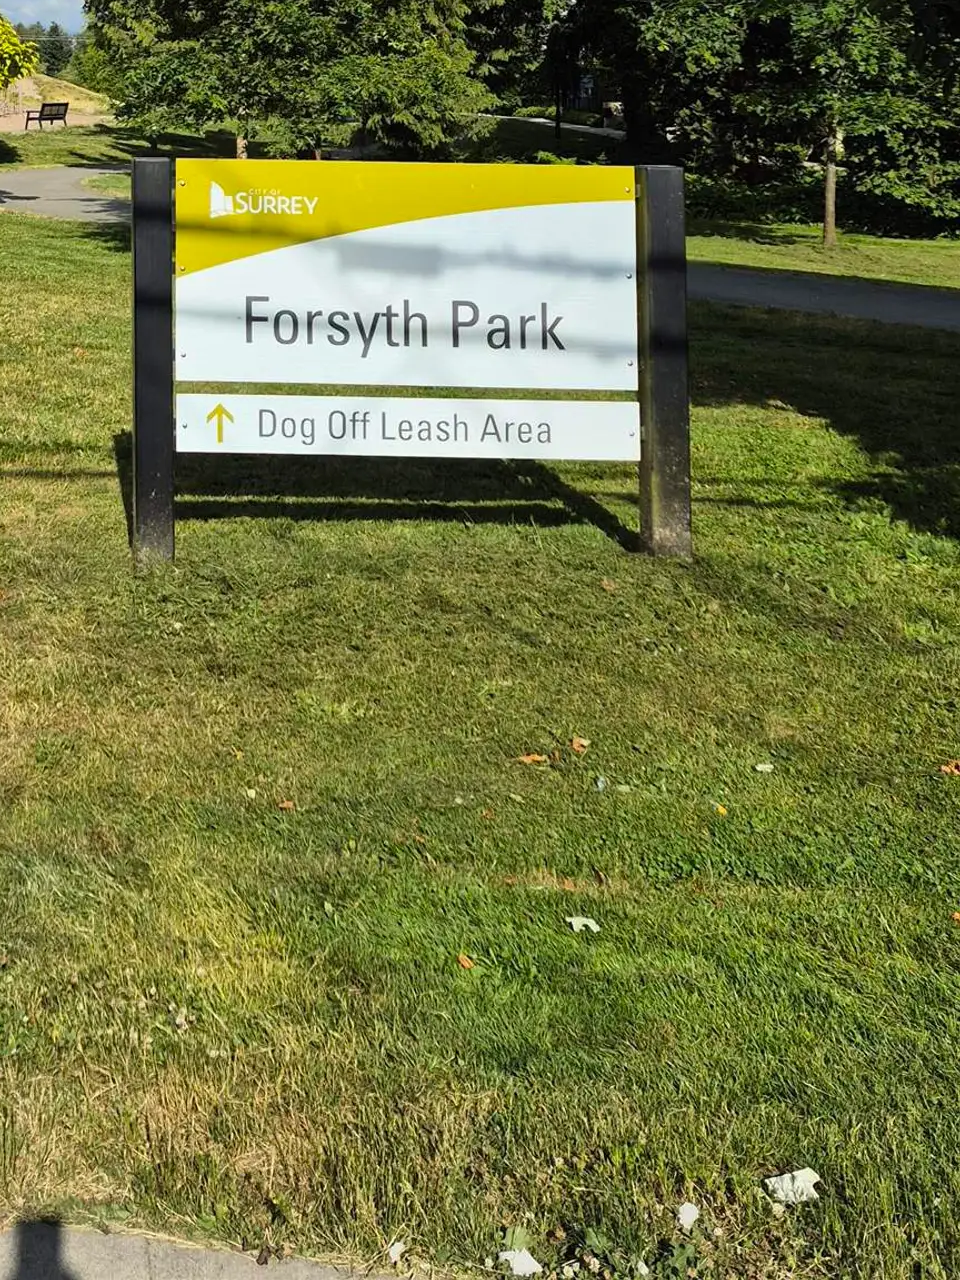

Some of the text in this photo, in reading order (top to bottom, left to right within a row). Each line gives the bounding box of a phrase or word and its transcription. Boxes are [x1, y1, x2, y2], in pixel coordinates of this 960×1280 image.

[235, 192, 318, 215] SURREY
[244, 295, 567, 358] Forsyth Park
[258, 408, 552, 445] Dog Off Leash Area
